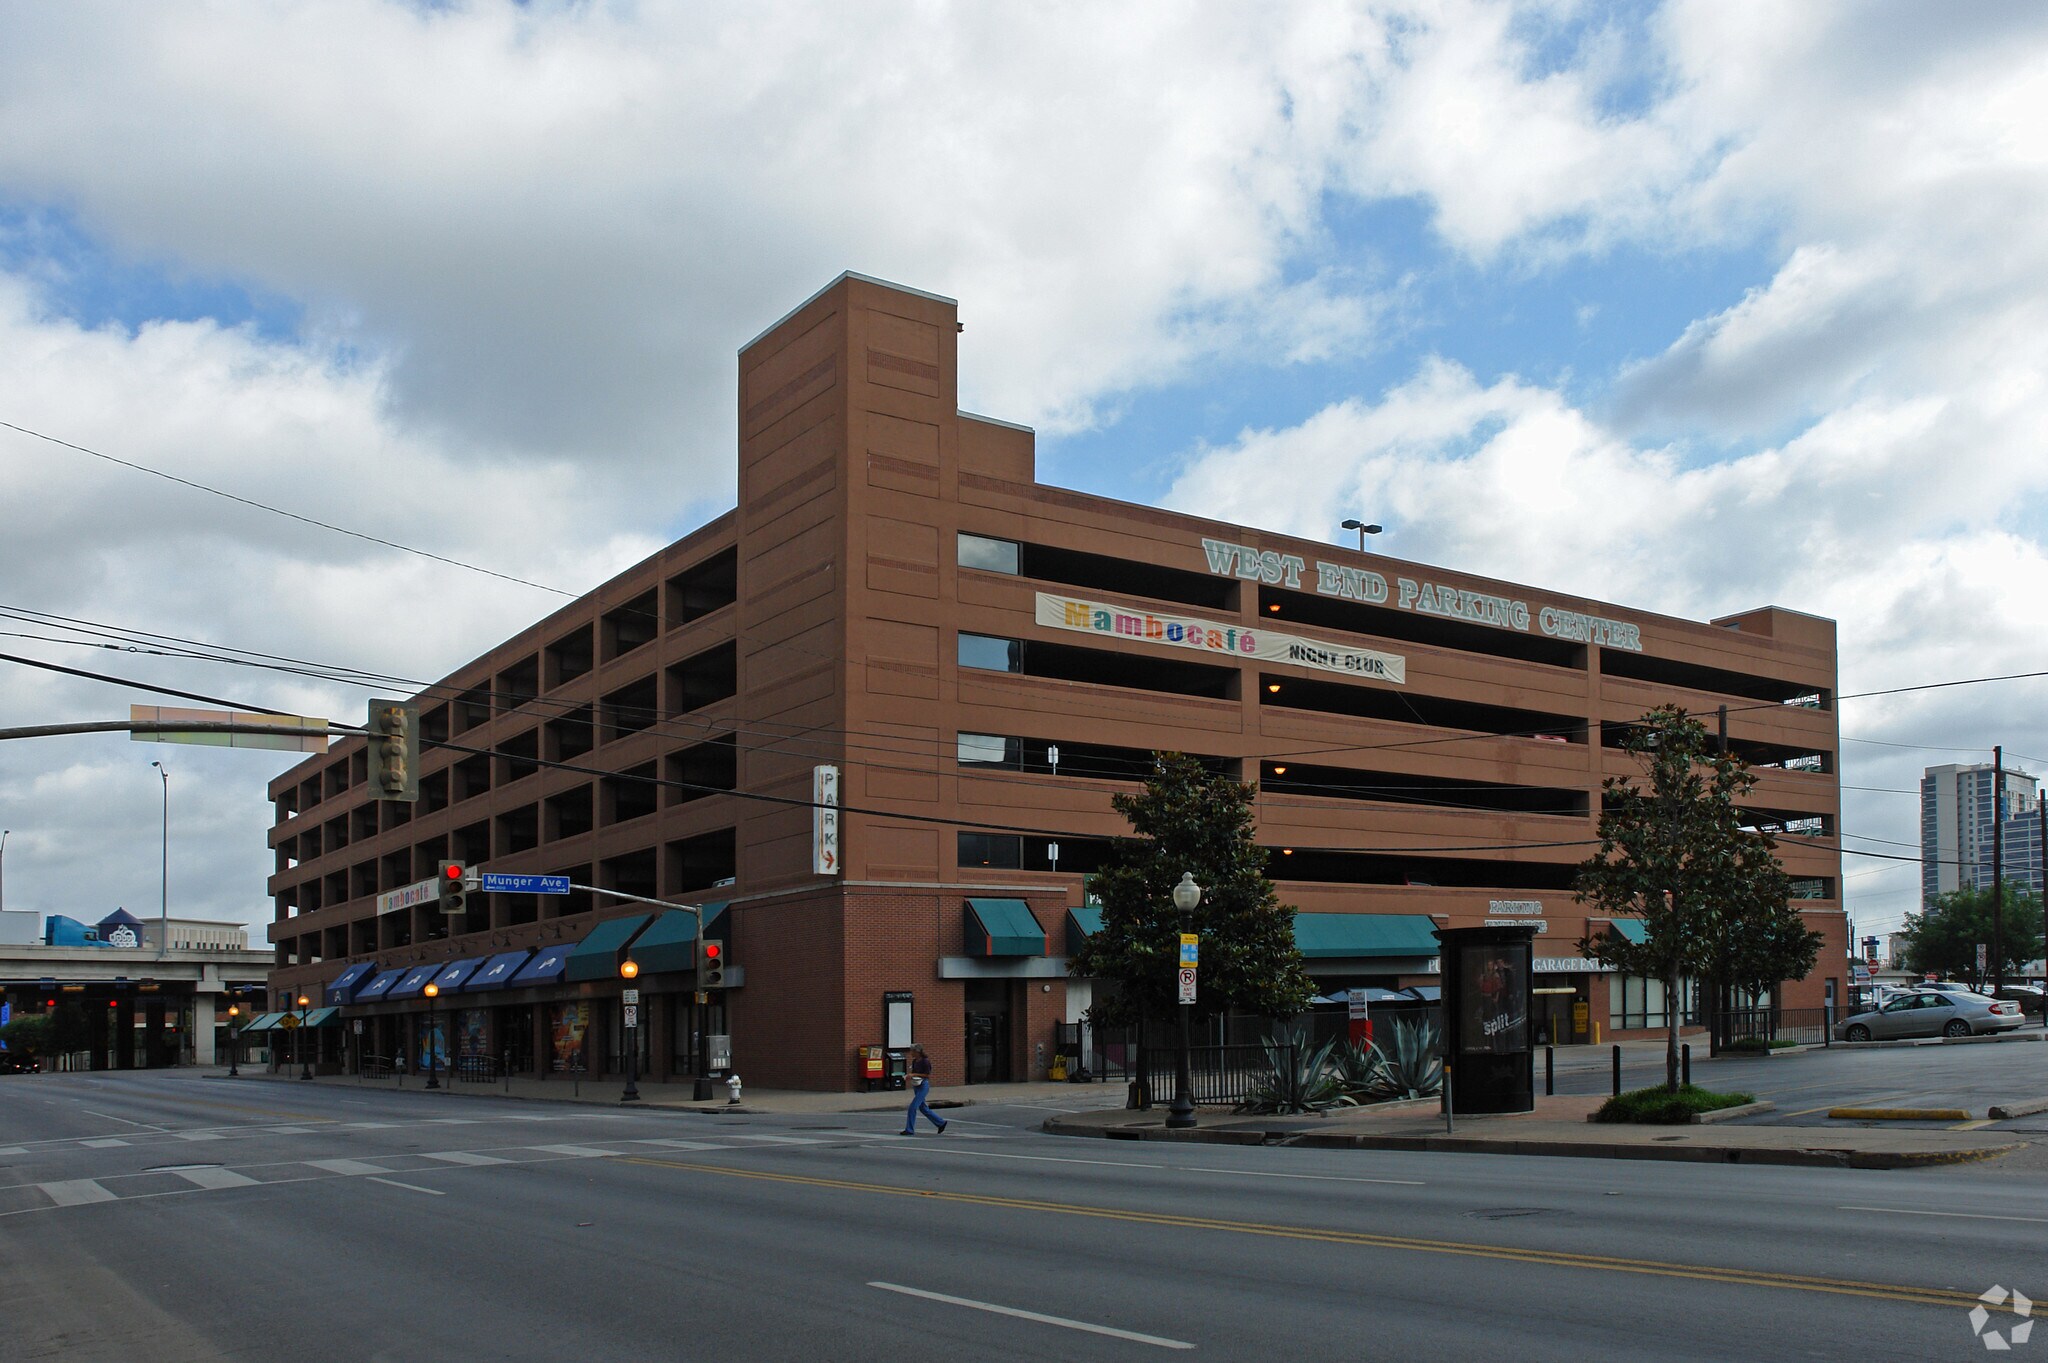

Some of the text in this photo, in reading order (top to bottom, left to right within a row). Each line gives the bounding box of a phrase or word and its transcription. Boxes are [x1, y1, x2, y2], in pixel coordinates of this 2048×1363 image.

[1202, 538, 1643, 651] WEST END PARKING CENTER
[1065, 601, 1384, 674] Mambocafé NIGHT CLUB
[824, 773, 835, 845] PARK
[487, 875, 565, 888] Munger Ave.
[1489, 901, 1543, 914] PARKING
[1533, 958, 1578, 970] GARAGE
[1483, 1013, 1509, 1036] split
